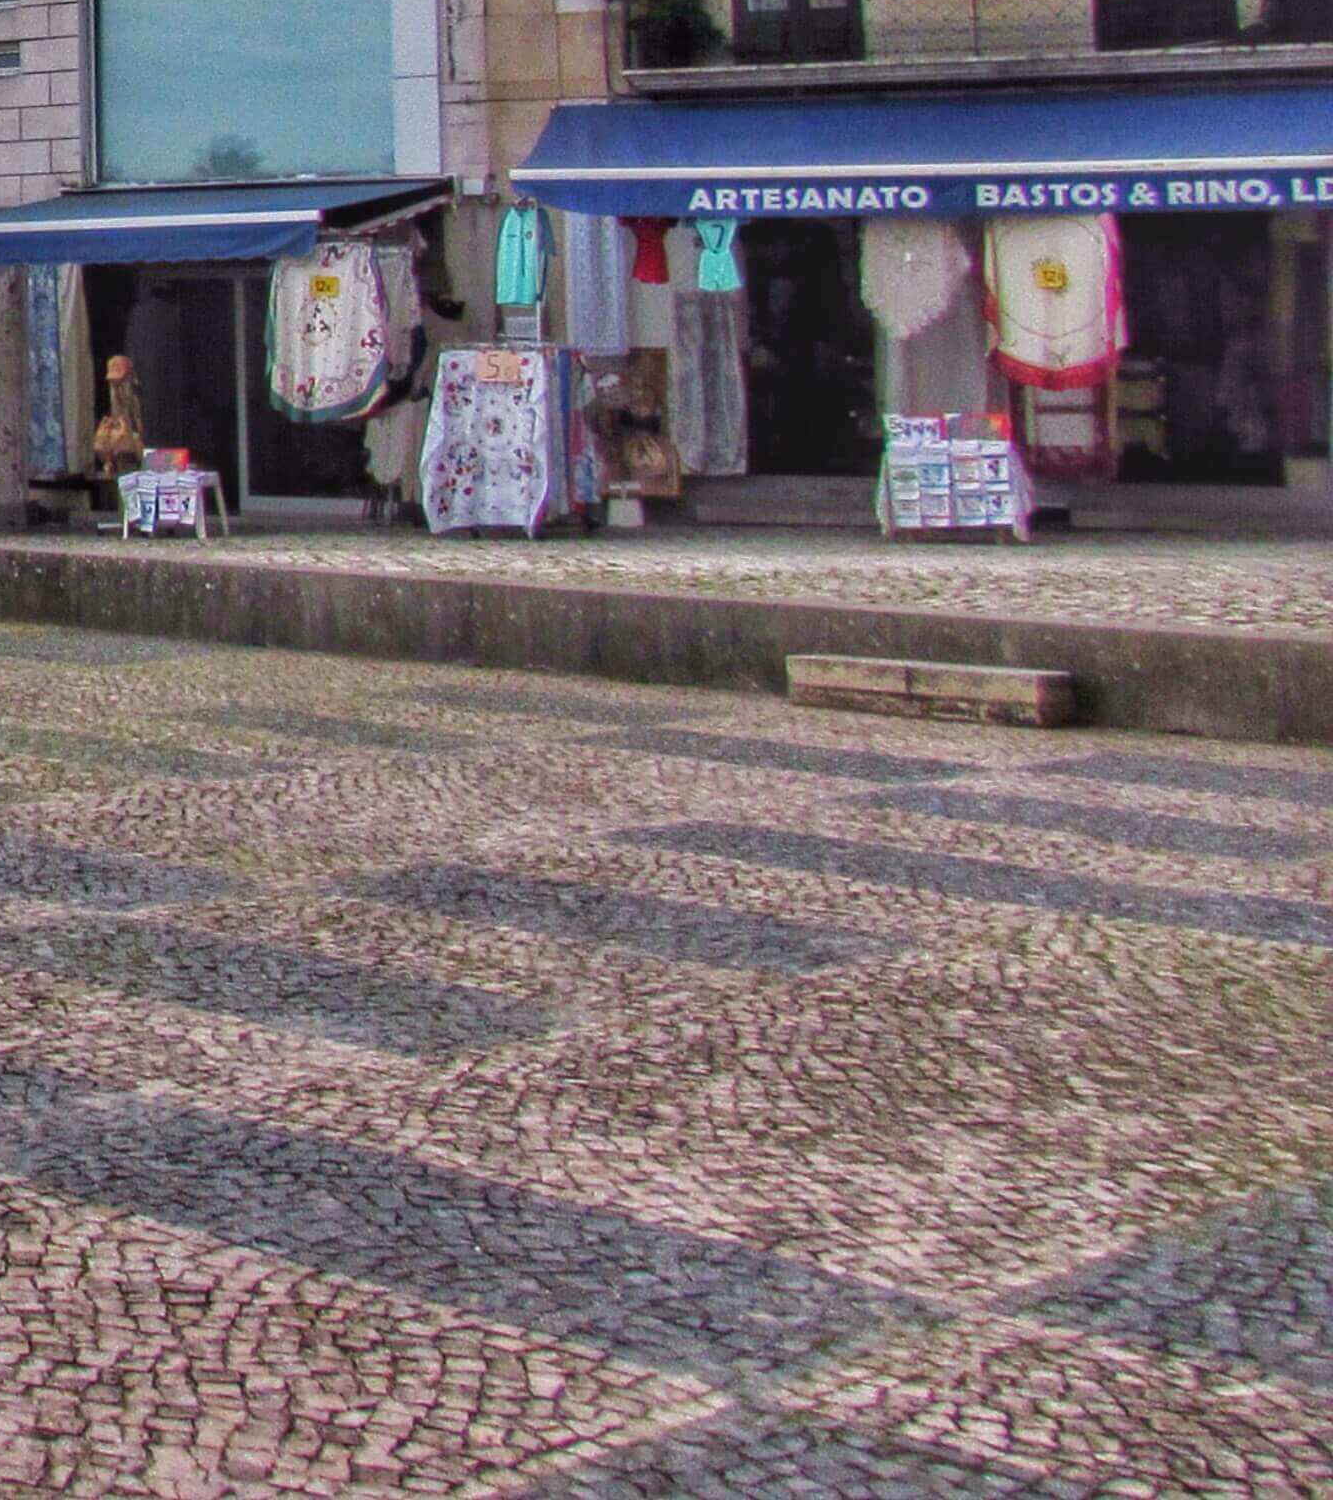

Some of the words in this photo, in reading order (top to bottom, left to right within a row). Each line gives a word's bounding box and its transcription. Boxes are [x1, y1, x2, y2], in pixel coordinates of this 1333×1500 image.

[688, 185, 930, 211] ARTESANATO
[975, 183, 1116, 207] BASTOS
[1129, 182, 1159, 206] &
[1166, 179, 1281, 206] RINO,
